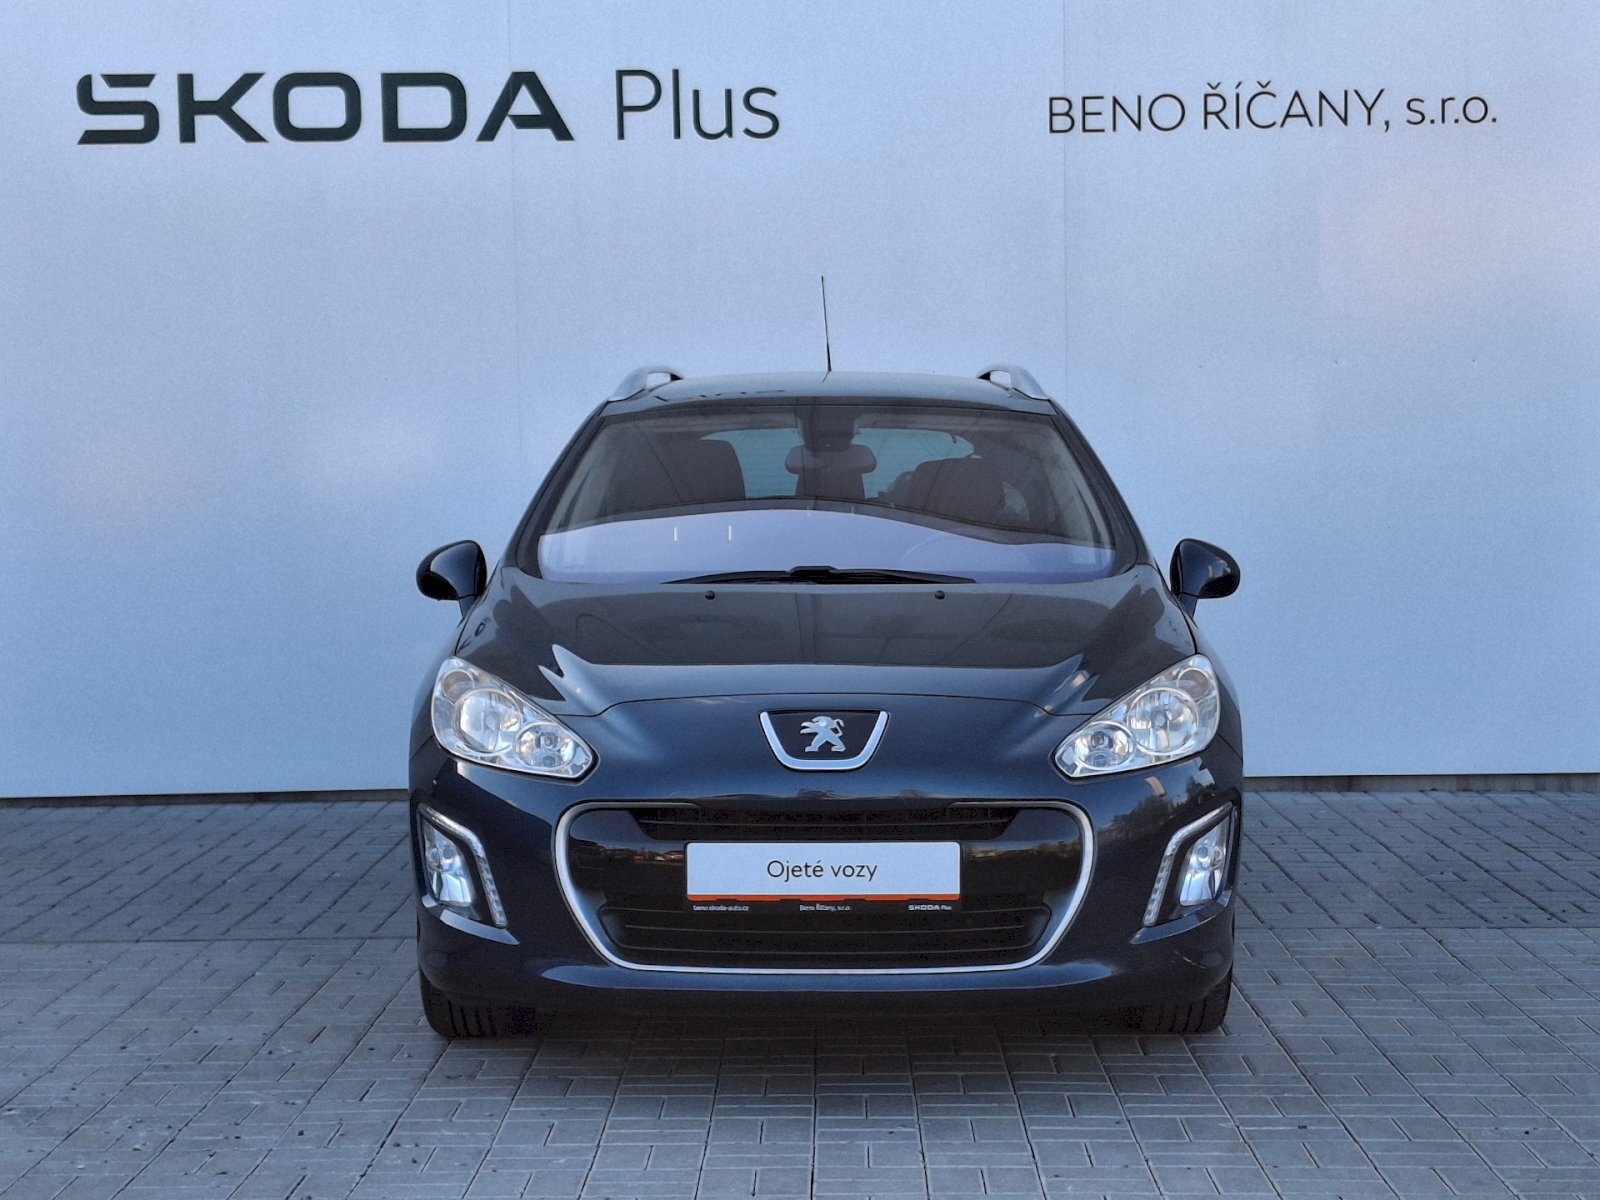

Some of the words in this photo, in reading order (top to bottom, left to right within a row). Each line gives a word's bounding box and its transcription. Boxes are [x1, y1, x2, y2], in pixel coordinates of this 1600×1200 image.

[615, 68, 780, 141] Plus
[1048, 93, 1186, 134] BENO
[1203, 80, 1390, 133] ŘÍČANY,
[1406, 96, 1498, 126] s.r.o.
[766, 859, 824, 883] Ojeté
[830, 864, 878, 882] vozy
